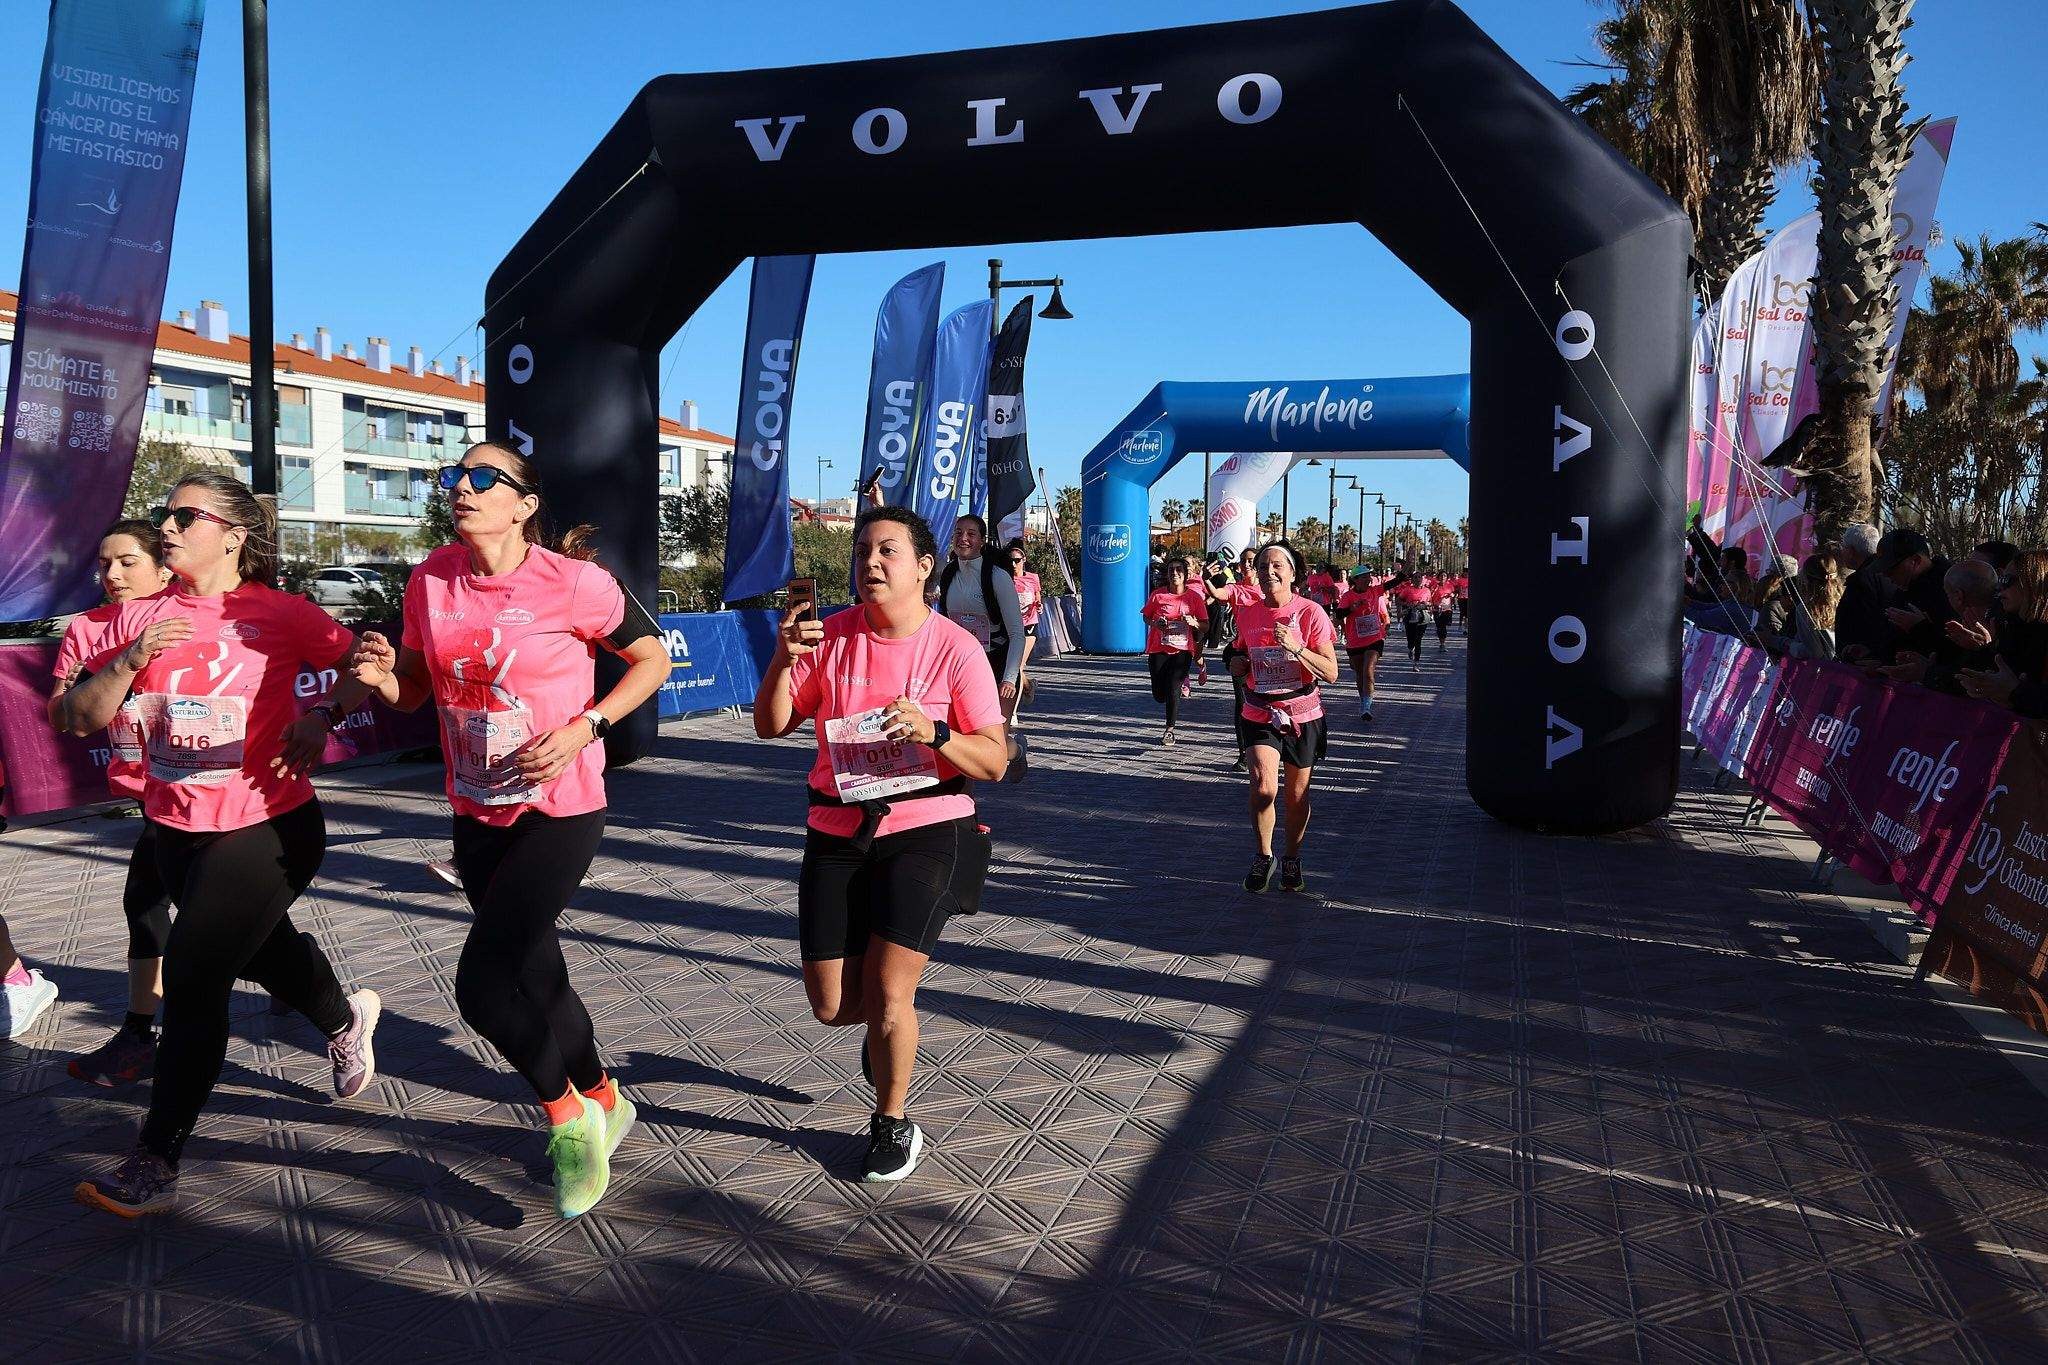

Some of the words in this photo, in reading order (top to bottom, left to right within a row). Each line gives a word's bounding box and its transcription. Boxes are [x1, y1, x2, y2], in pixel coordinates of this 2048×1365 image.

[52, 63, 182, 105] VISIBILICEMOS
[40, 104, 105, 137] CÁNCER
[109, 122, 131, 141] DE
[135, 128, 179, 150] MAMA
[65, 92, 133, 118] JUNTOS
[138, 106, 157, 124] EL
[735, 73, 1283, 162] VOLVO
[48, 135, 164, 170] METASTÁSICO
[1757, 308, 1780, 320] Sal
[25, 349, 101, 380] SÚMATE
[103, 369, 119, 383] AL
[1697, 363, 1714, 375] Sa
[22, 372, 118, 400] MOVIMIENTO
[751, 338, 793, 471] GOYA
[879, 379, 915, 488] GOYA
[931, 401, 965, 499] GOYA
[1546, 310, 1596, 769] VOLVO
[659, 629, 689, 657] YA
[169, 734, 211, 750] 016
[866, 742, 903, 763] 016
[1808, 706, 1861, 767] renfe
[851, 785, 882, 798] OYSHO
[1887, 740, 1959, 814] renfe
[2000, 857, 2048, 909] Odonto
